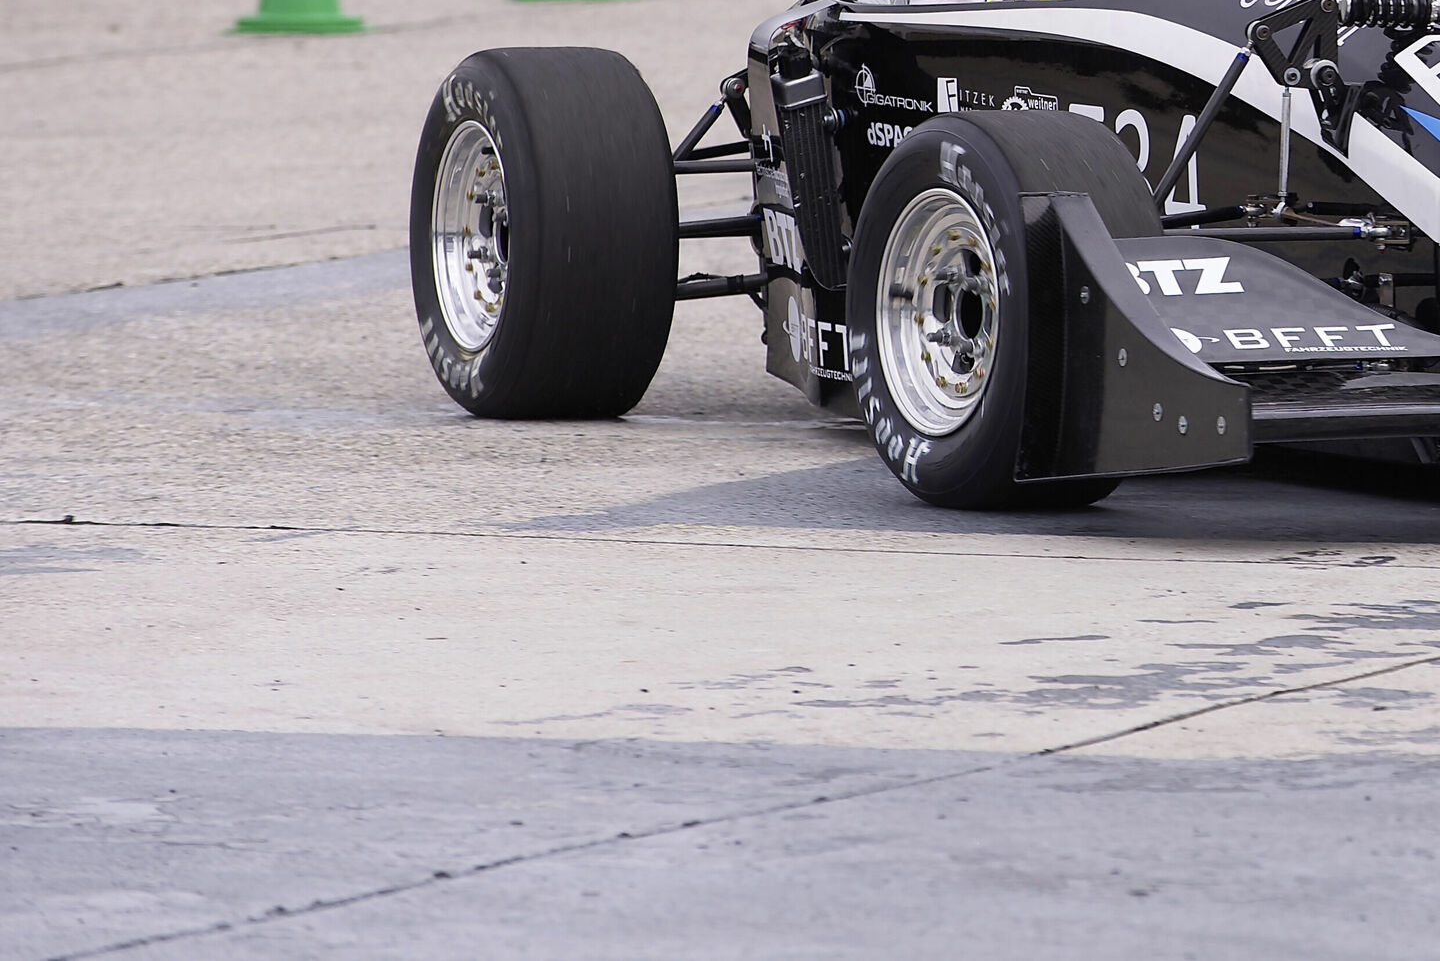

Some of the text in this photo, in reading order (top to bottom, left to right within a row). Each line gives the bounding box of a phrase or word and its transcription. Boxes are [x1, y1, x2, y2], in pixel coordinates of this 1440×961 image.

[867, 94, 933, 113] GIGATRONIK
[1069, 103, 1206, 229] 34
[1222, 323, 1399, 350] BFFT
